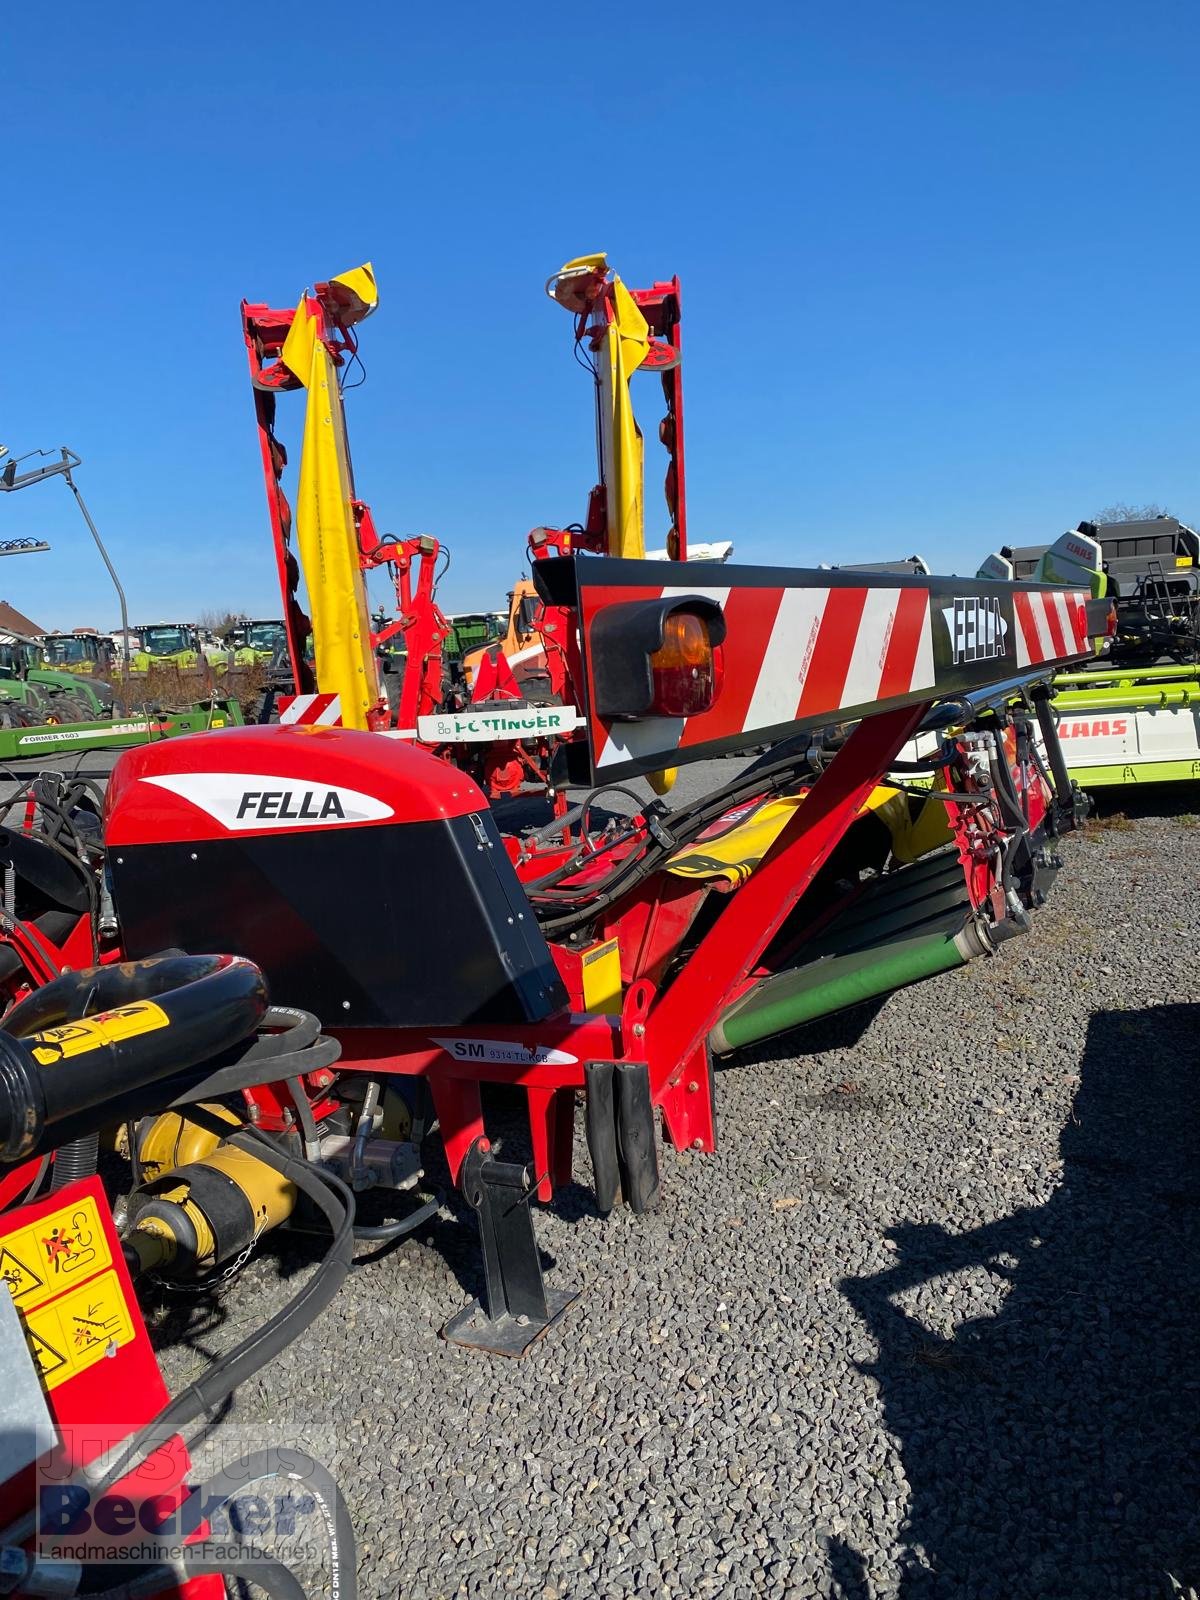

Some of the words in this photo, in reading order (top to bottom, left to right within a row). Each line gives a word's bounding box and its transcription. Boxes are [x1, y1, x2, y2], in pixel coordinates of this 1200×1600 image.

[952, 597, 1006, 665] FELLA
[1056, 720, 1126, 739] LAAS
[236, 792, 345, 818] FELLA
[454, 1042, 485, 1057] SM
[332, 1561, 340, 1588] DN12
